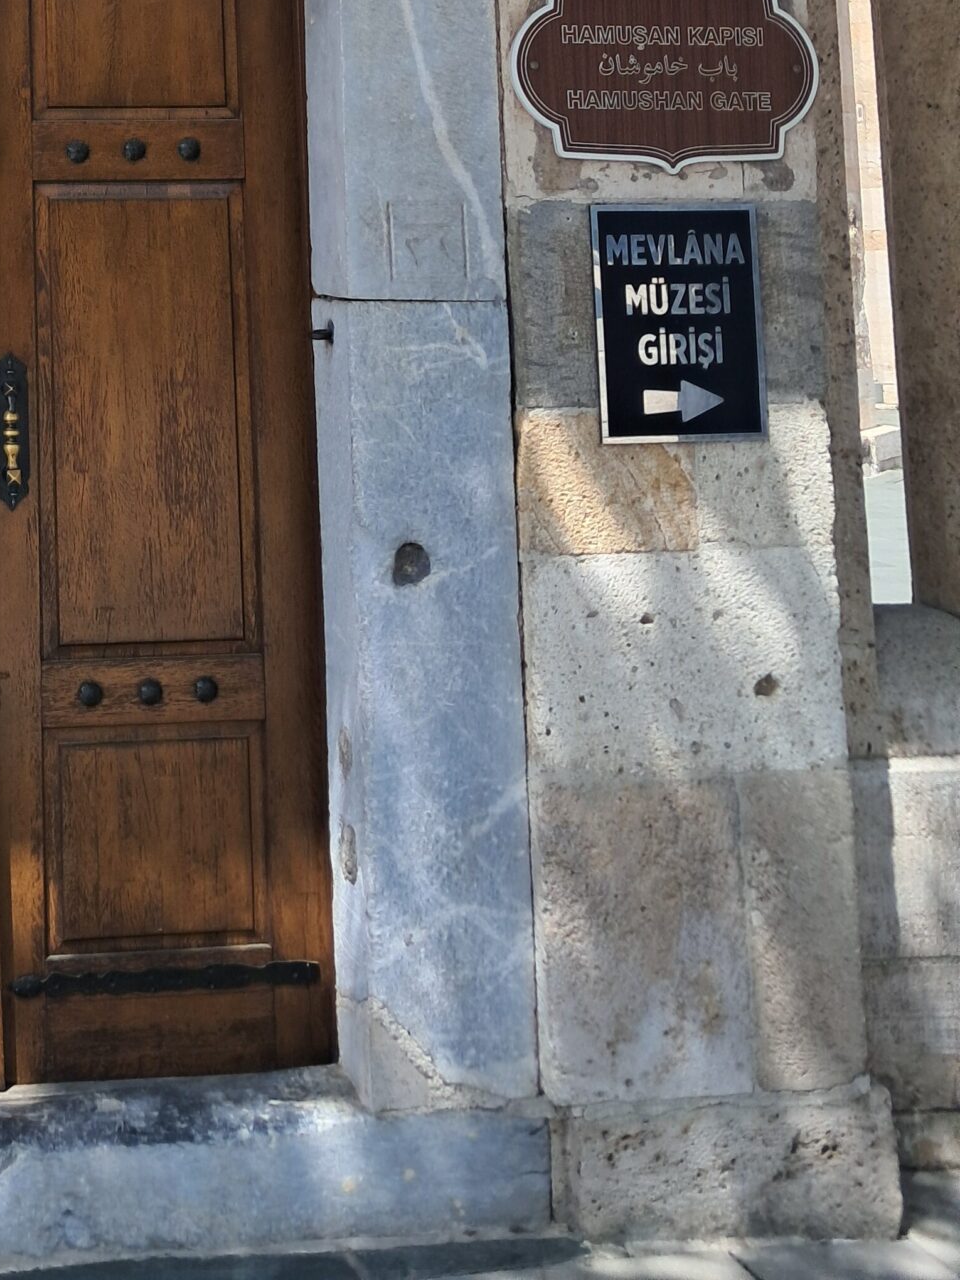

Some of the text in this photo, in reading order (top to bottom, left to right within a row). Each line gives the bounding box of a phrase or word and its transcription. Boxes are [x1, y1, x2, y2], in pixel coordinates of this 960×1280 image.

[560, 24, 765, 50] HAMUŞAN KAPISI
[598, 53, 739, 84] باب خاموشان
[566, 89, 772, 112] HAMUSHAN GATE
[605, 229, 746, 266] MEVLÂNA
[624, 276, 732, 316] MÜZESİ
[637, 326, 724, 370] GİRİŞİ
